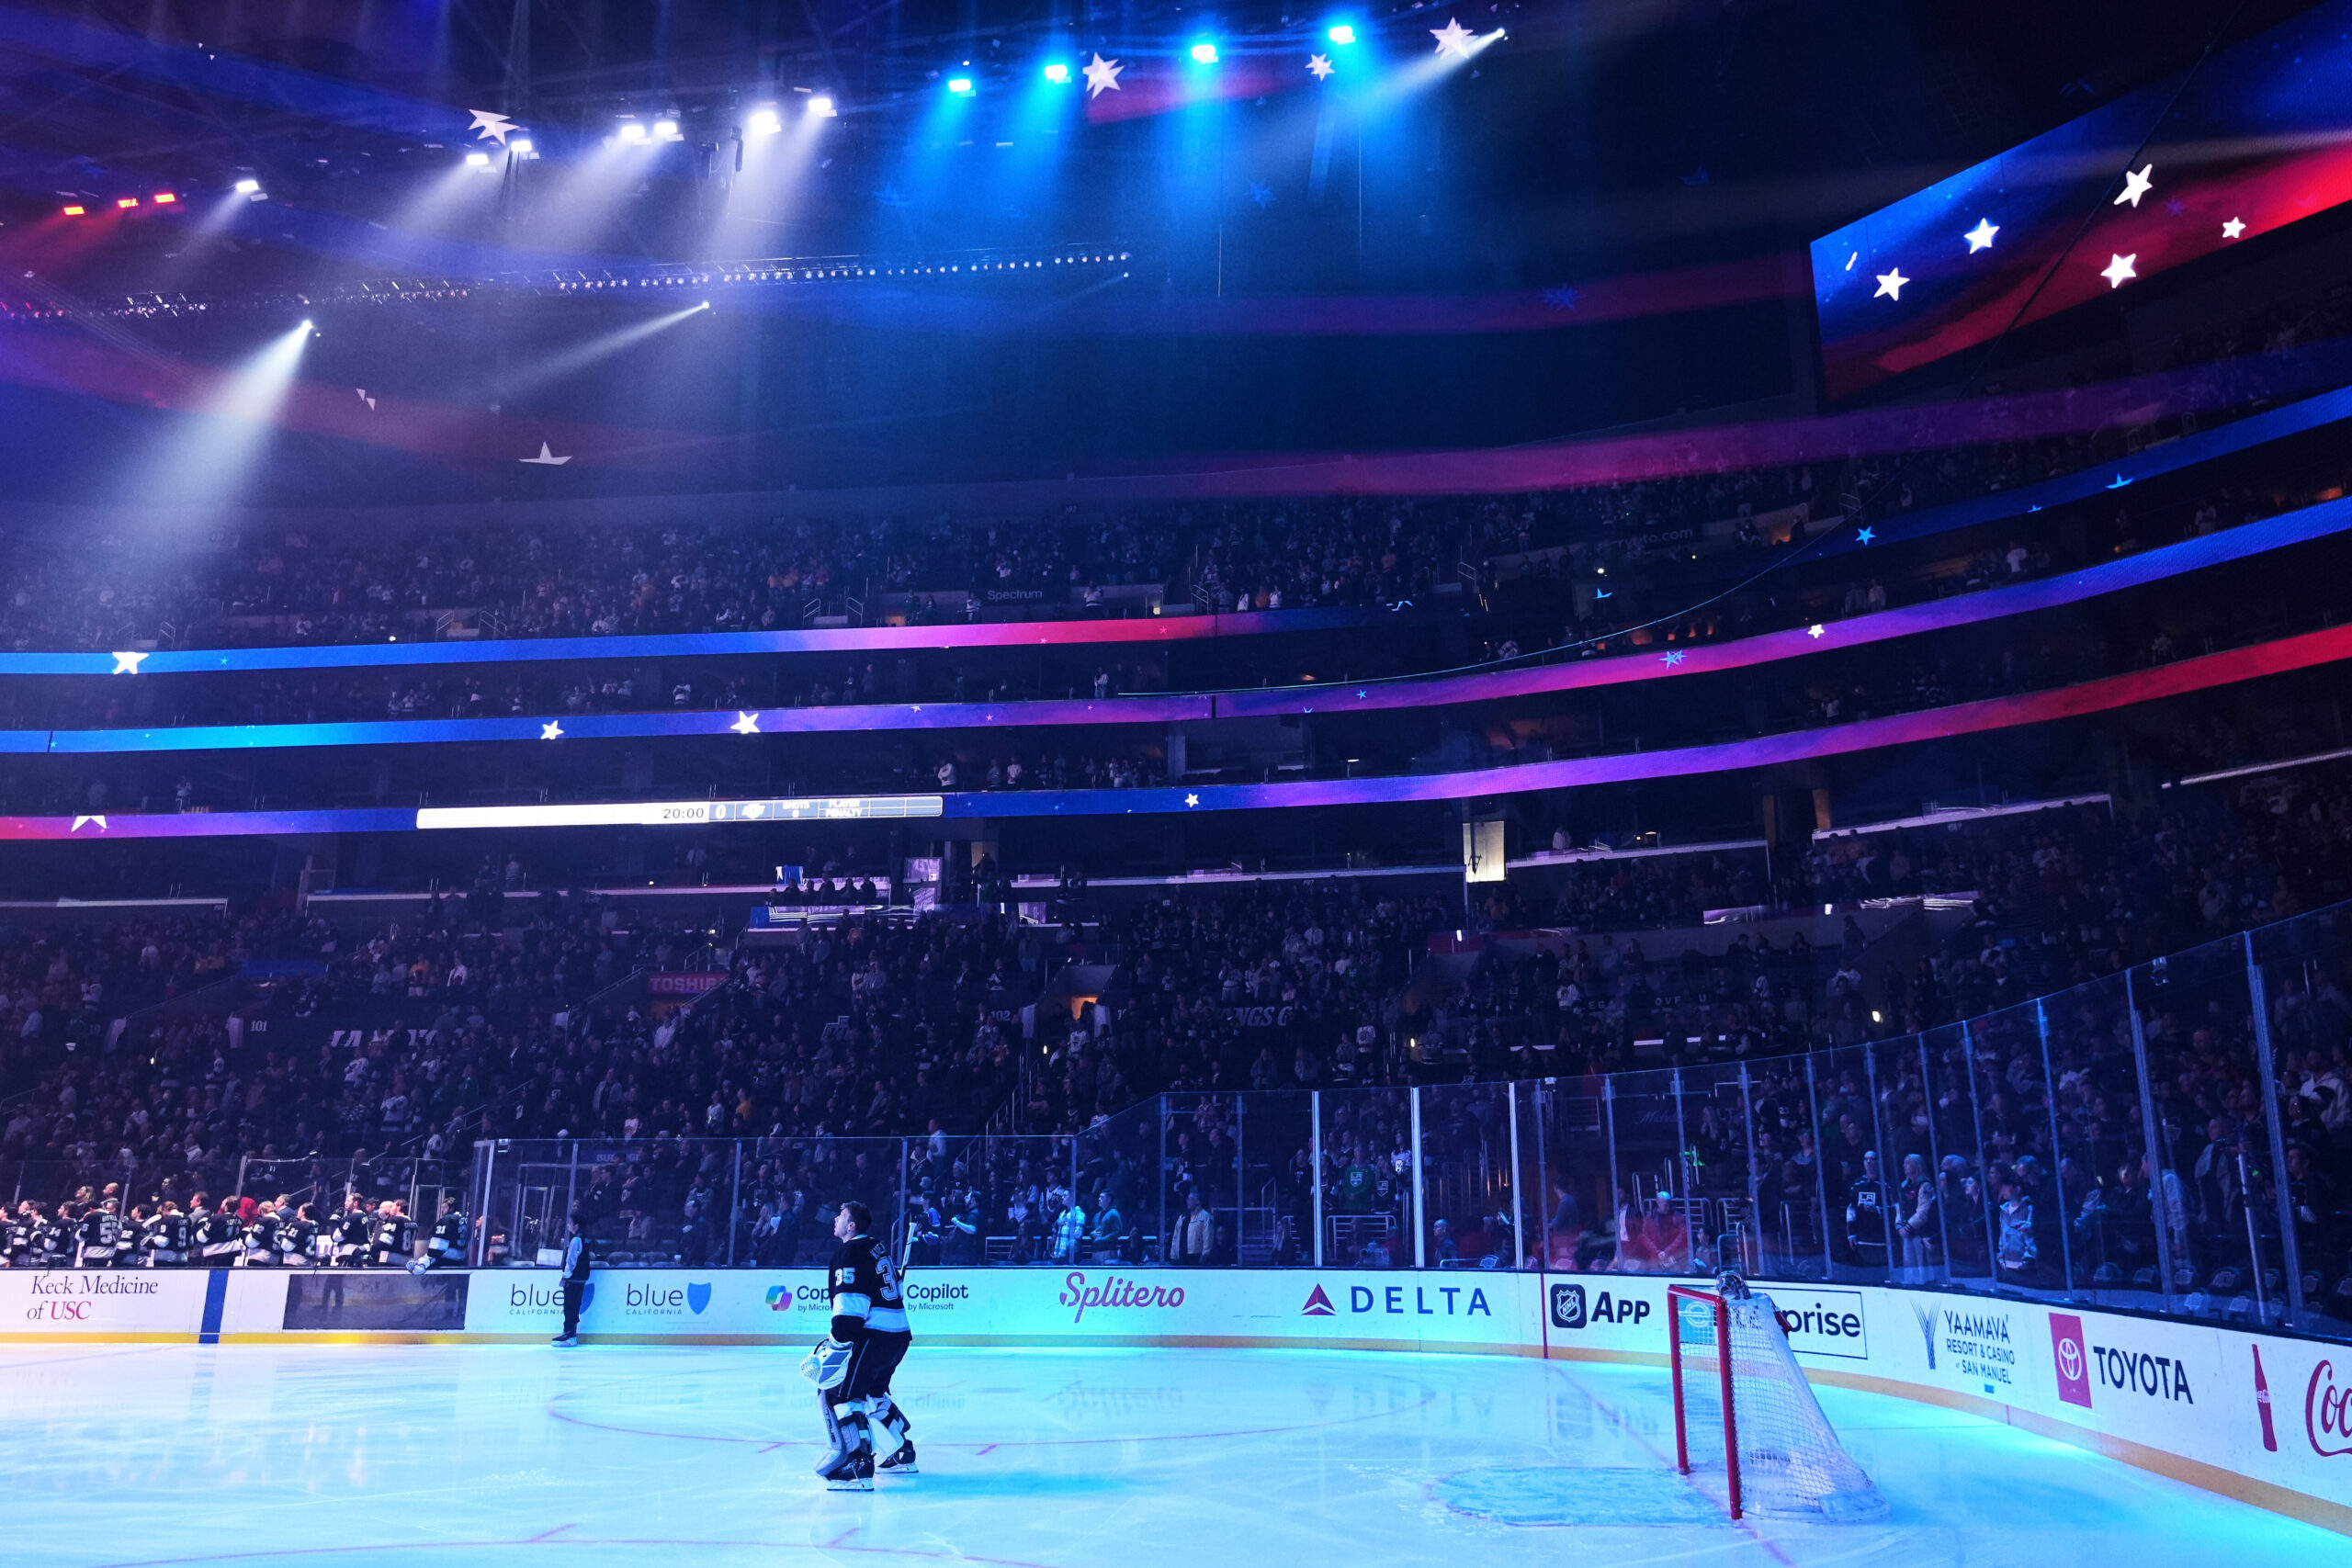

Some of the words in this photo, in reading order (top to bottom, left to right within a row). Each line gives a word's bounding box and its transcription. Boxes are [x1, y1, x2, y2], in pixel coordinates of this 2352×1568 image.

[987, 589, 1043, 603] Spectrum
[662, 807, 705, 819] 20:00
[716, 805, 726, 819] 0
[825, 807, 862, 818] PENALTY
[829, 799, 860, 808] PLAYER
[650, 976, 717, 992] TOSHIB
[250, 1021, 267, 1032] 101
[1234, 1006, 1275, 1027] NGS
[120, 1230, 133, 1239] 22
[160, 1224, 167, 1233] 9
[177, 1226, 187, 1248] 9
[435, 1224, 447, 1235] 31
[30, 1275, 74, 1295] Keck
[78, 1275, 159, 1295] Medicine
[834, 1267, 855, 1287] 35
[875, 1256, 899, 1301] 3
[510, 1283, 565, 1306] blue
[626, 1283, 684, 1306] blue
[907, 1283, 968, 1303] Copilot
[1059, 1271, 1185, 1324] Splitero
[1351, 1285, 1492, 1316] DELTA
[27, 1301, 49, 1320] of
[50, 1301, 92, 1320] USC
[797, 1303, 807, 1312] by
[908, 1303, 917, 1312] by
[918, 1302, 955, 1311] Microsoft
[1590, 1292, 1650, 1325] App
[1781, 1302, 1860, 1337] prise
[1946, 1338, 1977, 1357] RESORT
[1980, 1344, 1985, 1358] &
[1986, 1345, 2015, 1365] CASINO
[1962, 1359, 1978, 1376] SAN
[1980, 1363, 2012, 1384] MANUEL
[2093, 1346, 2194, 1404] TOYOTA
[2305, 1359, 2352, 1457] Coc
